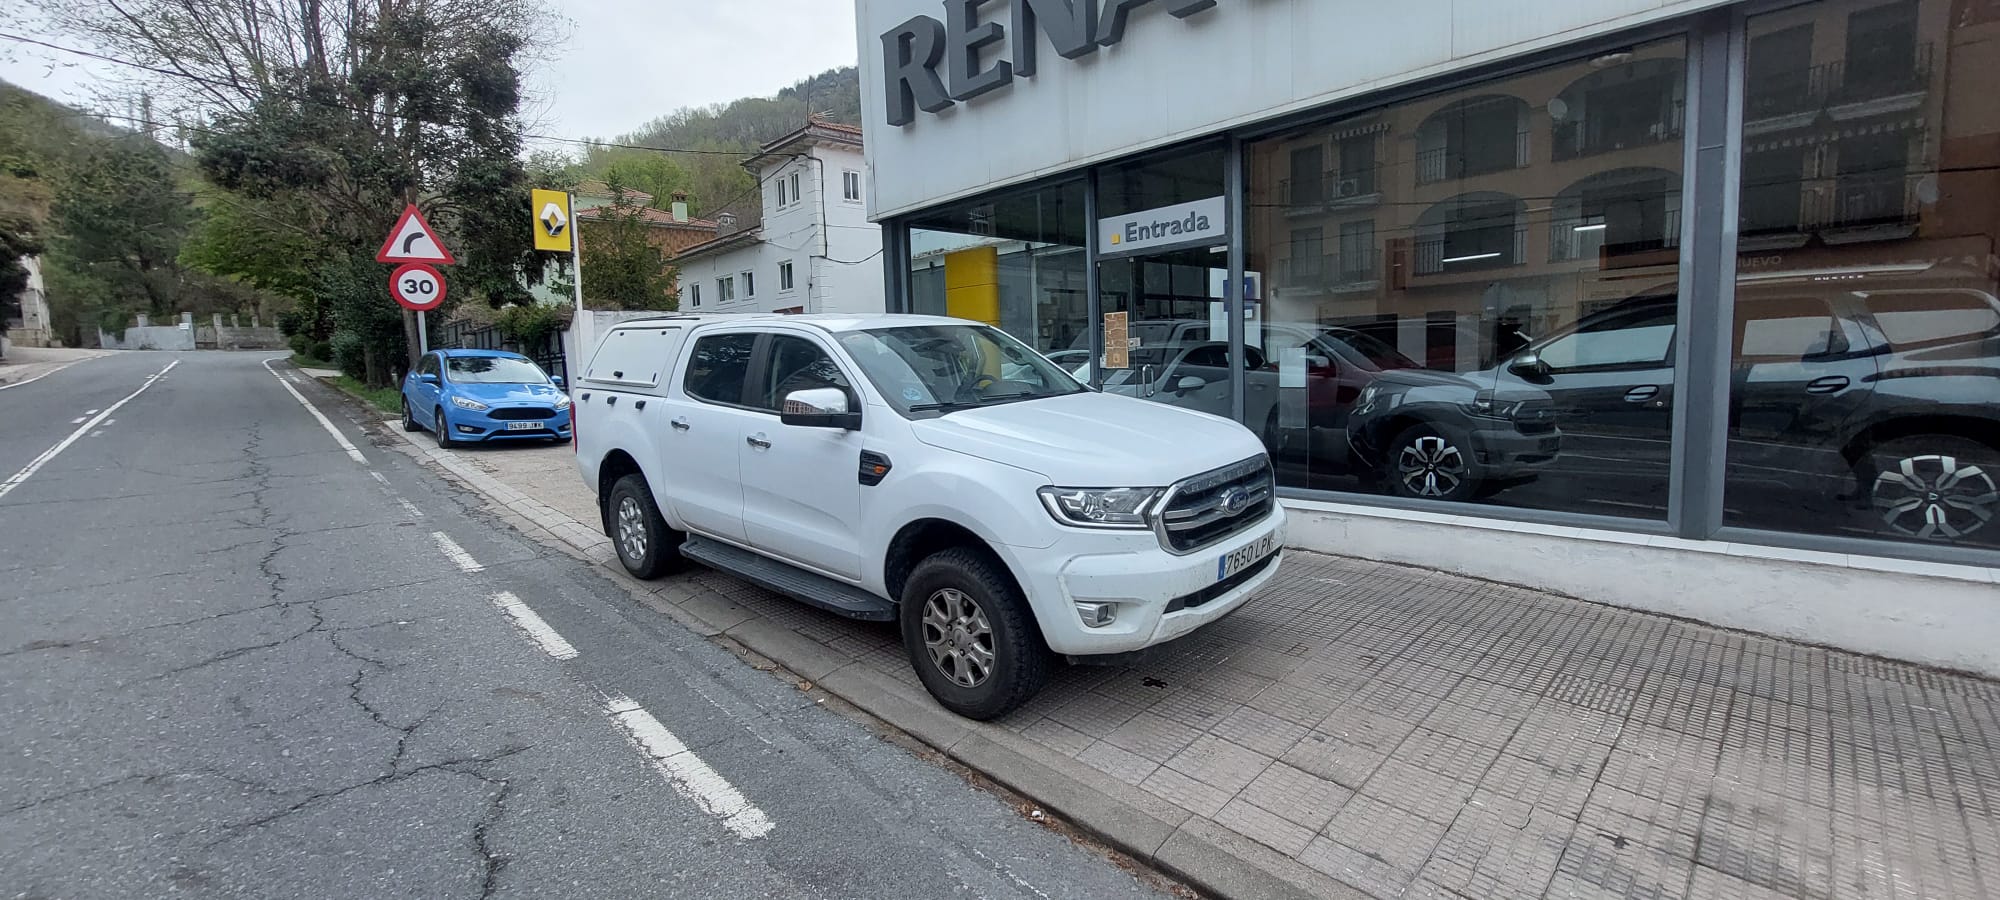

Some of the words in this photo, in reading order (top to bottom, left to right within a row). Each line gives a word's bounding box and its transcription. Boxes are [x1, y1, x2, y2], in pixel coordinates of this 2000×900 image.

[1125, 211, 1210, 243] Entrada
[1737, 256, 1783, 269] UEVO
[404, 279, 434, 295] 30
[1226, 545, 1254, 574] 7650
[1255, 533, 1273, 559] LPK
